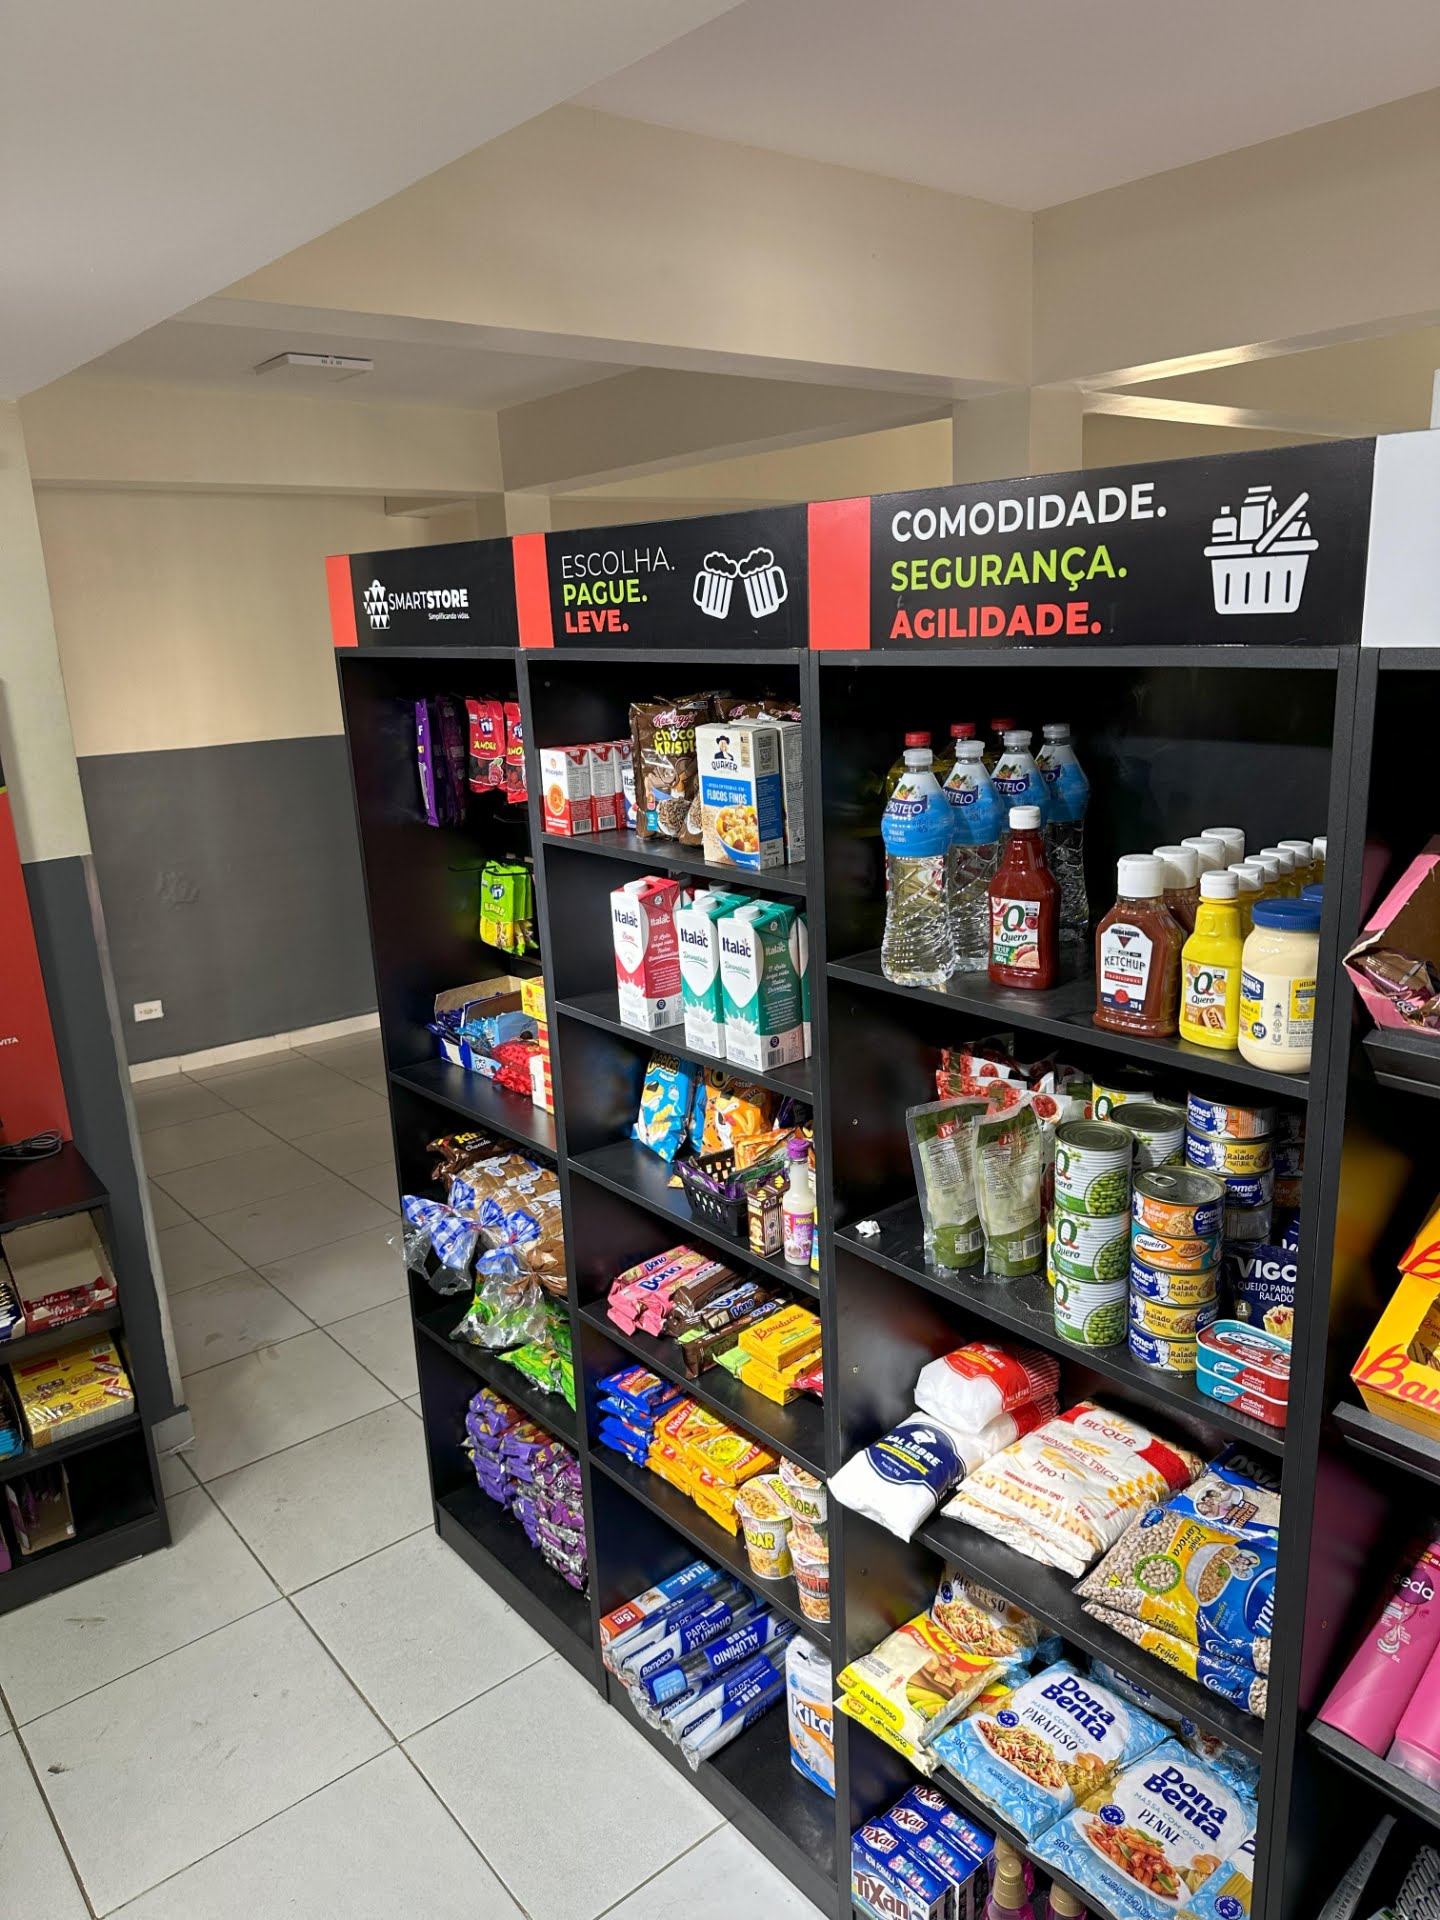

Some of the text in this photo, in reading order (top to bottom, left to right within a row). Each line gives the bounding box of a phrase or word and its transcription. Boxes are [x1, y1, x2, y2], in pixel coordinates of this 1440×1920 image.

[890, 482, 1168, 541] COMODIDADE.
[560, 547, 675, 579] ESCOLHA.
[890, 543, 1128, 594] SEGURANÇA.
[388, 588, 469, 611] SMARTSTORE
[562, 578, 649, 606] PAGUE.
[565, 609, 629, 634] LEVE.
[888, 600, 1102, 640] AGILIDADE.
[614, 909, 638, 928] Italac
[680, 928, 709, 948] Italac
[722, 937, 752, 958] Italac
[1000, 932, 1028, 944] Quero
[1105, 955, 1146, 971] KETCHUP
[1191, 994, 1216, 1004] Quero
[1144, 1206, 1169, 1219] Ralado
[1136, 1235, 1167, 1249] Coqueiro
[638, 1264, 682, 1291] Bono
[1171, 1283, 1198, 1291] Ralado
[1237, 1281, 1268, 1293] QUEIJO
[730, 1299, 755, 1319] Bono
[1259, 1291, 1294, 1303] RALADO
[752, 1312, 804, 1341] Bauducco
[1146, 1311, 1171, 1324] Ralado
[1171, 1350, 1197, 1358] Ralado
[1241, 1378, 1266, 1393] tomate
[1240, 1402, 1265, 1418] tomate
[885, 1434, 906, 1447] SAL
[904, 1441, 941, 1467] LEBRE
[1032, 1459, 1058, 1478] TIPO
[1088, 1456, 1119, 1482] TRIGO
[1172, 1524, 1202, 1557] Carioca
[953, 1572, 1006, 1613] PARAFUSO
[1393, 1573, 1434, 1601] seda
[614, 1610, 637, 1625] 15m
[685, 1618, 712, 1641] PAPEL
[1154, 1614, 1179, 1632] Feijão
[642, 1647, 672, 1676] Bompack
[1155, 1642, 1180, 1663] Feijão
[1203, 1672, 1243, 1700] Camil
[1041, 1683, 1107, 1742] Benta
[1058, 1676, 1116, 1726] Dona
[1022, 1706, 1078, 1751] PARAFUSO
[1053, 1714, 1070, 1729] COM
[1070, 1728, 1090, 1749] OVOS
[1143, 1773, 1223, 1842] Benta
[1161, 1766, 1229, 1825] Dona
[890, 1808, 928, 1830] Tixan
[1134, 1792, 1207, 1851] MASSA COM OVOS
[1138, 1808, 1184, 1846] PENNE
[861, 1826, 899, 1848] Tixan
[853, 1869, 909, 1920] Tixan
